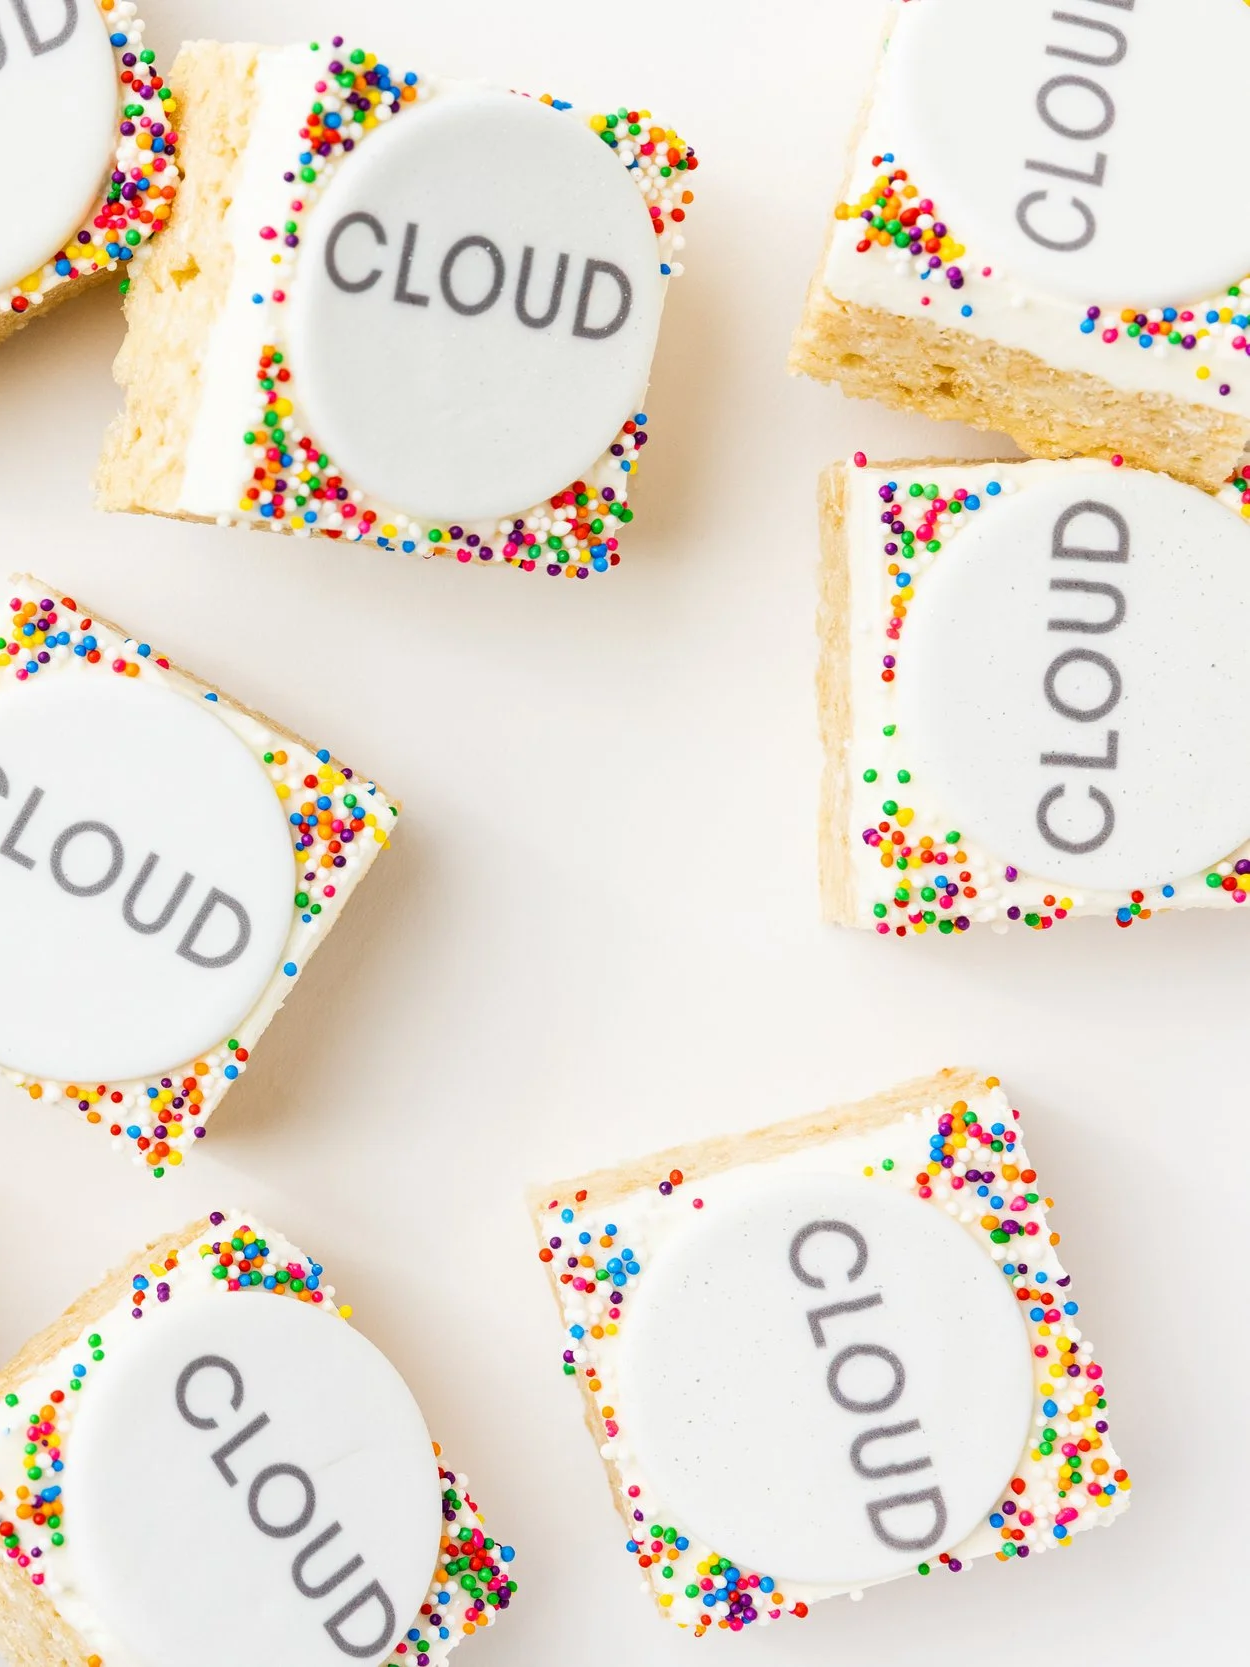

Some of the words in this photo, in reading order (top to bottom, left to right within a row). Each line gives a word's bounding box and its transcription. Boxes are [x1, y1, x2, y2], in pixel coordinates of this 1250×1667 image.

[323, 209, 634, 342] CLOUD
[1015, 0, 1136, 253] CLOU
[1035, 498, 1131, 856] CLOUD
[174, 1353, 397, 1660] CLOUD
[787, 1218, 948, 1553] CLOUD
